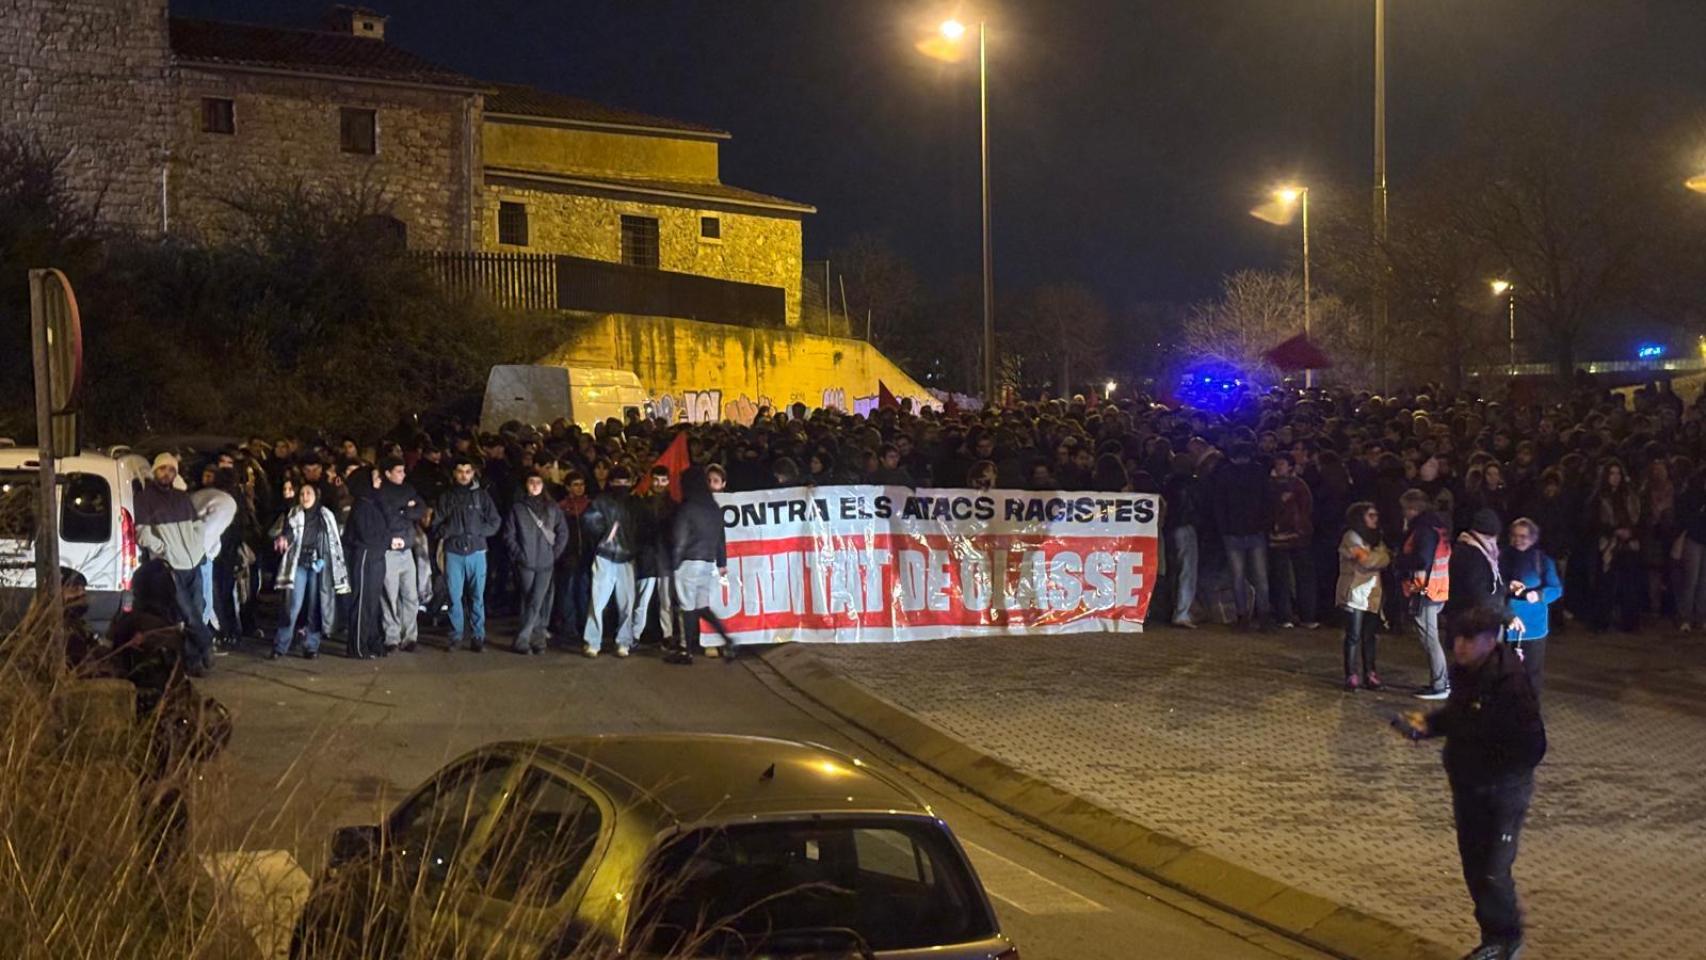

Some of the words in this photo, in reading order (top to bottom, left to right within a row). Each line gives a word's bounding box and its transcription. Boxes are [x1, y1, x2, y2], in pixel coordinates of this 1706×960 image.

[722, 499, 830, 528] ONTRA
[840, 496, 892, 520] ELS
[902, 496, 995, 521] ATACS
[1004, 497, 1155, 523] RACISTES
[709, 548, 893, 619] UNITAT
[898, 549, 950, 612] DE
[960, 550, 1143, 613] CLASSE
